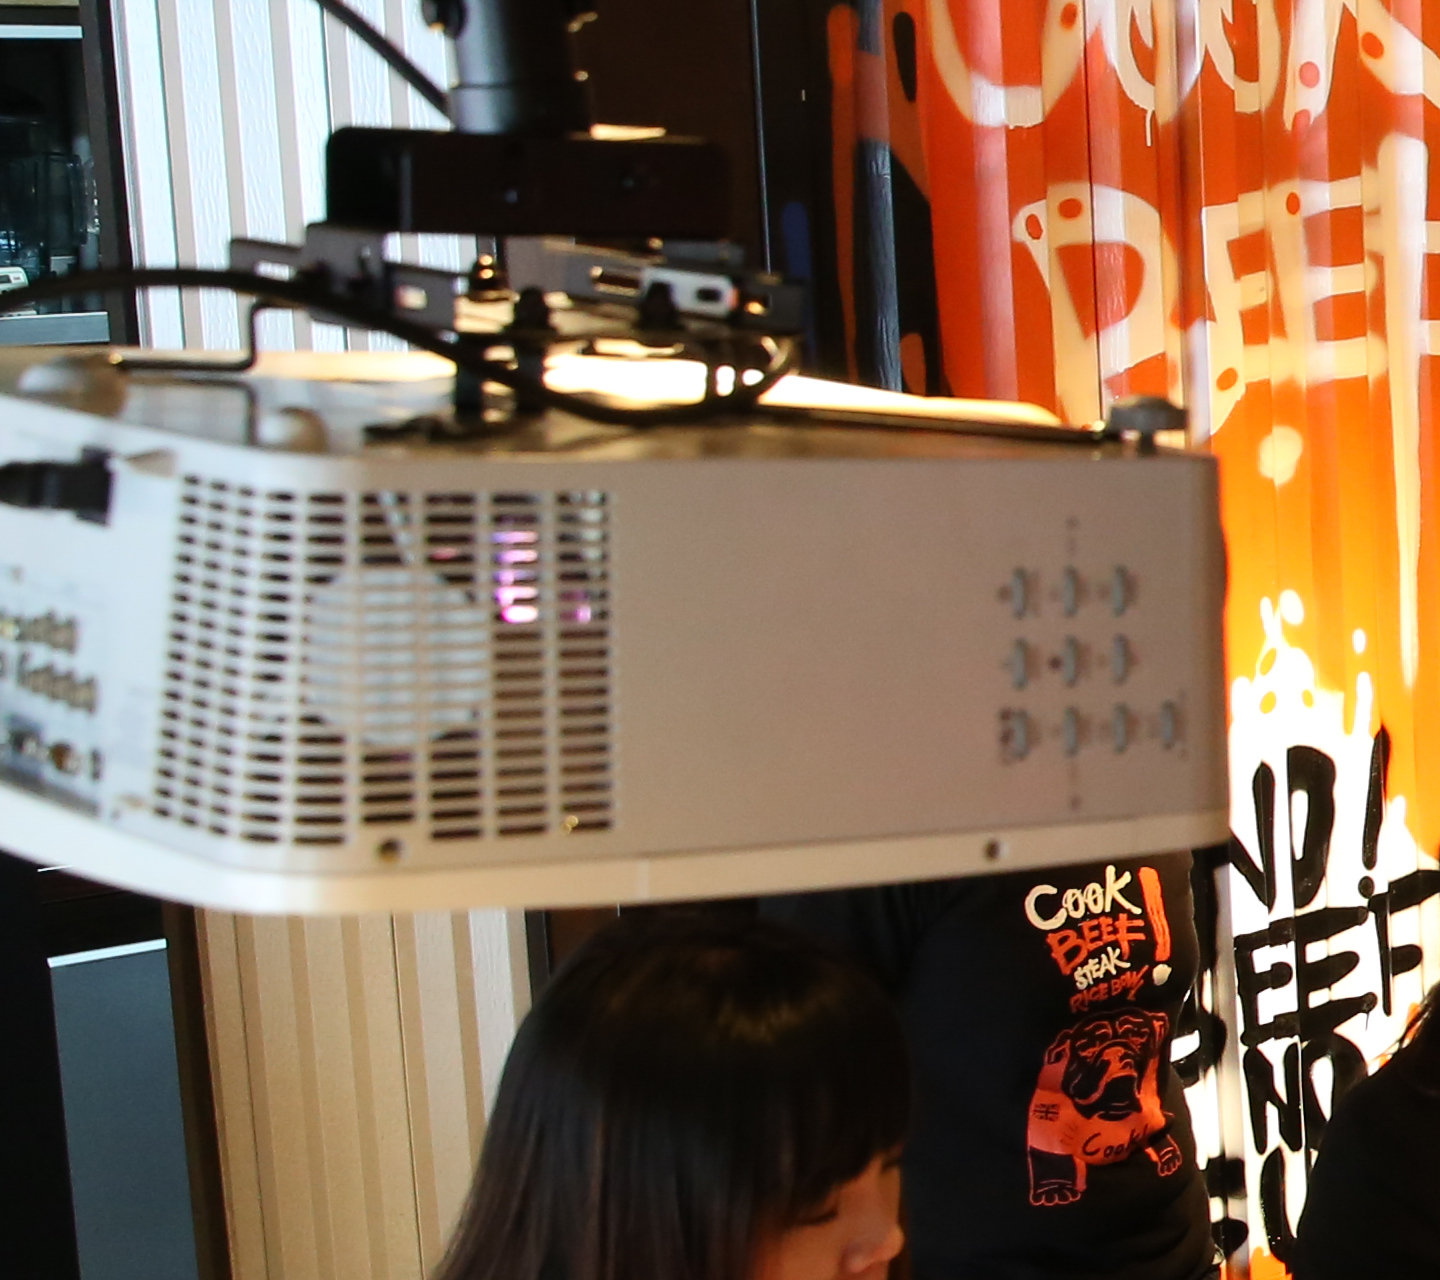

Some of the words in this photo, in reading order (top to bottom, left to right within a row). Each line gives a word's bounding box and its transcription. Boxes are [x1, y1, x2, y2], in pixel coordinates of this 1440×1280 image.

[1046, 913, 1146, 976] BEEF
[1074, 947, 1131, 989] STEAK
[1069, 982, 1109, 1014] RICE
